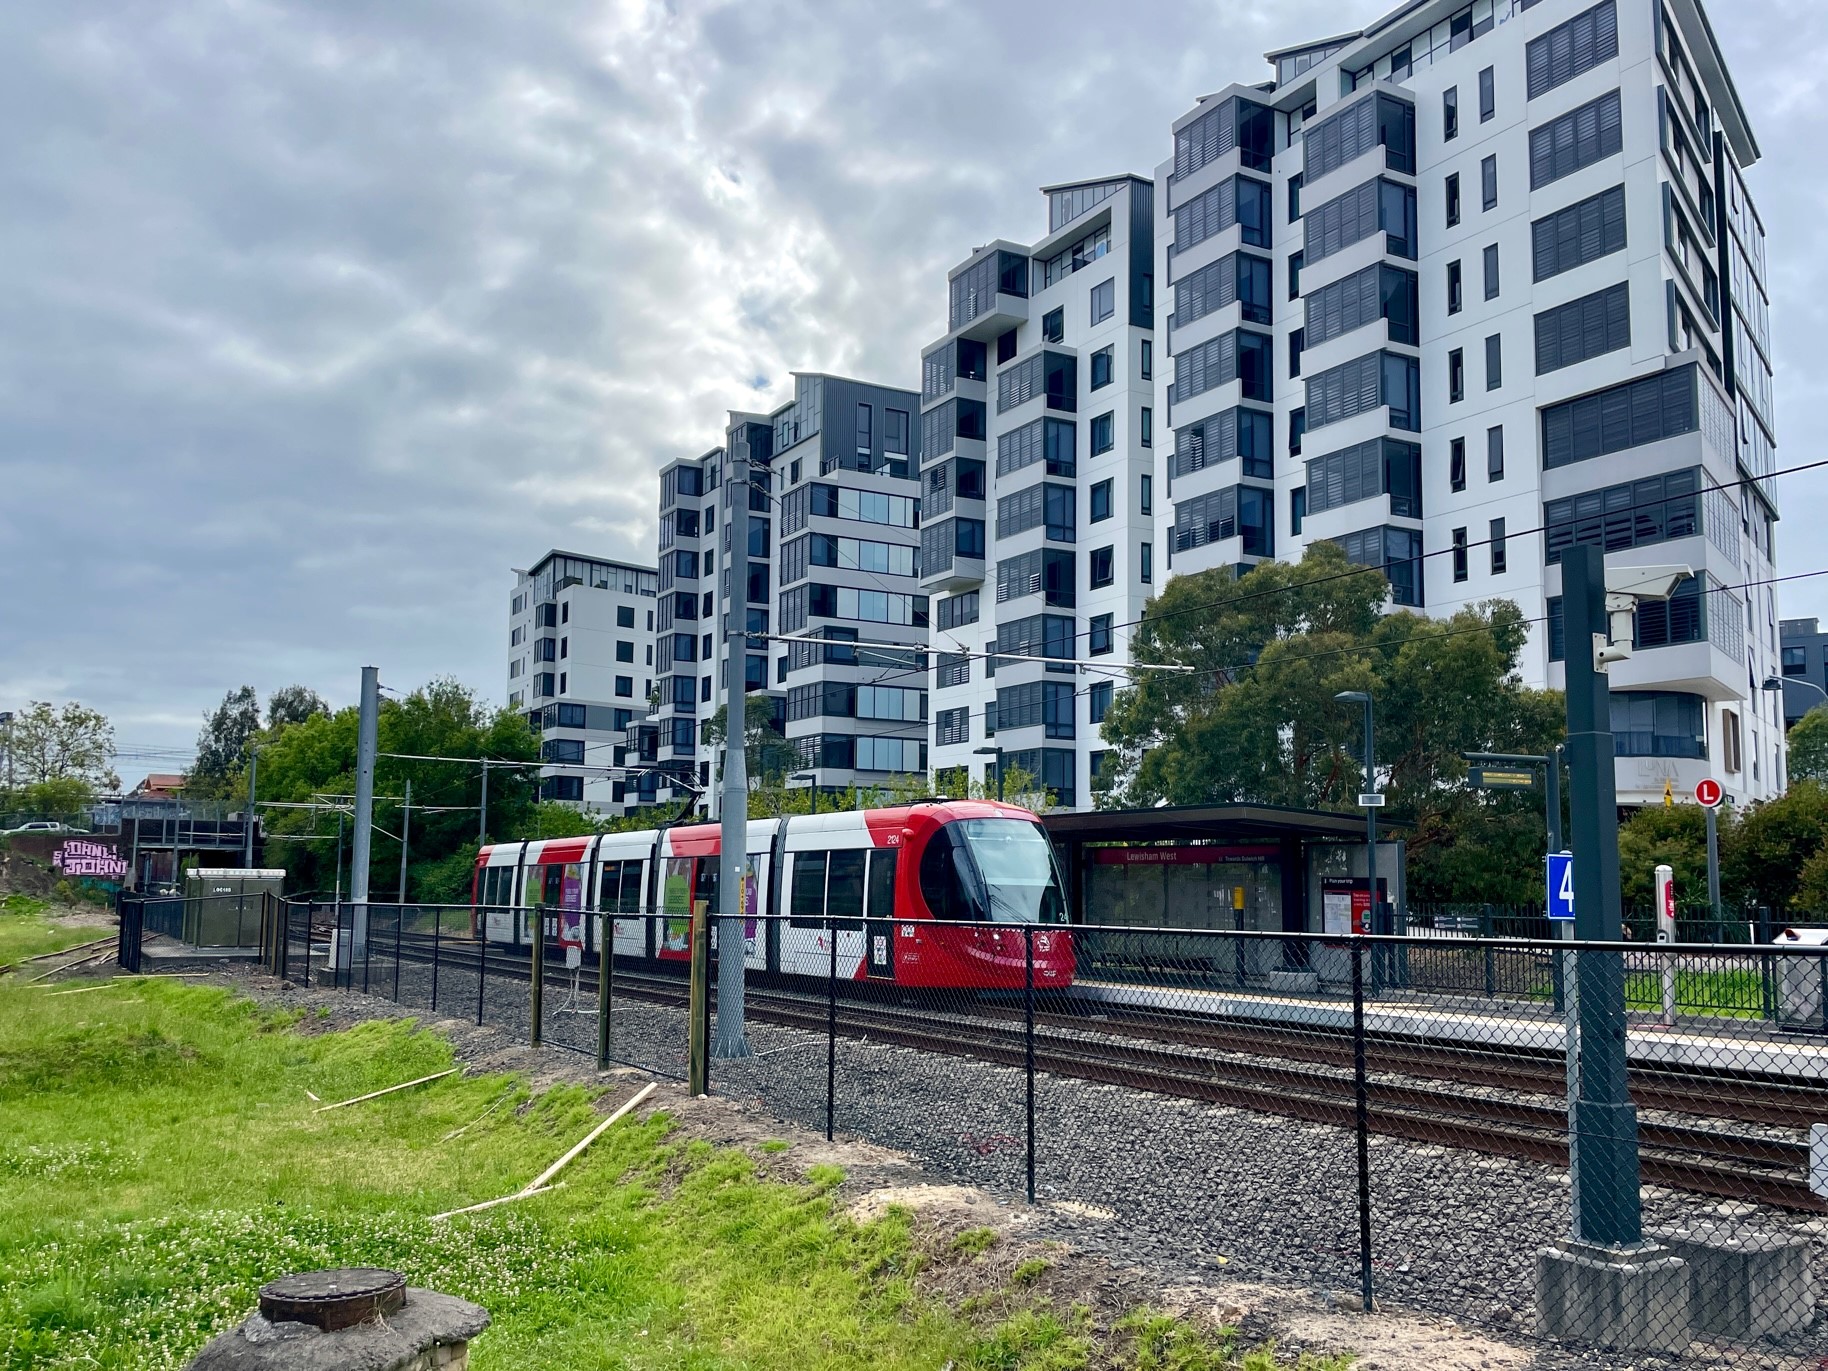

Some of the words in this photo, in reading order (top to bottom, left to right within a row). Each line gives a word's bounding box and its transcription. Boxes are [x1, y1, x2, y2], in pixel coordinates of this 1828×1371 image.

[1703, 784, 1714, 801] L
[1126, 851, 1159, 861] Lewisham
[1160, 851, 1177, 861] West
[1559, 860, 1575, 913] 4
